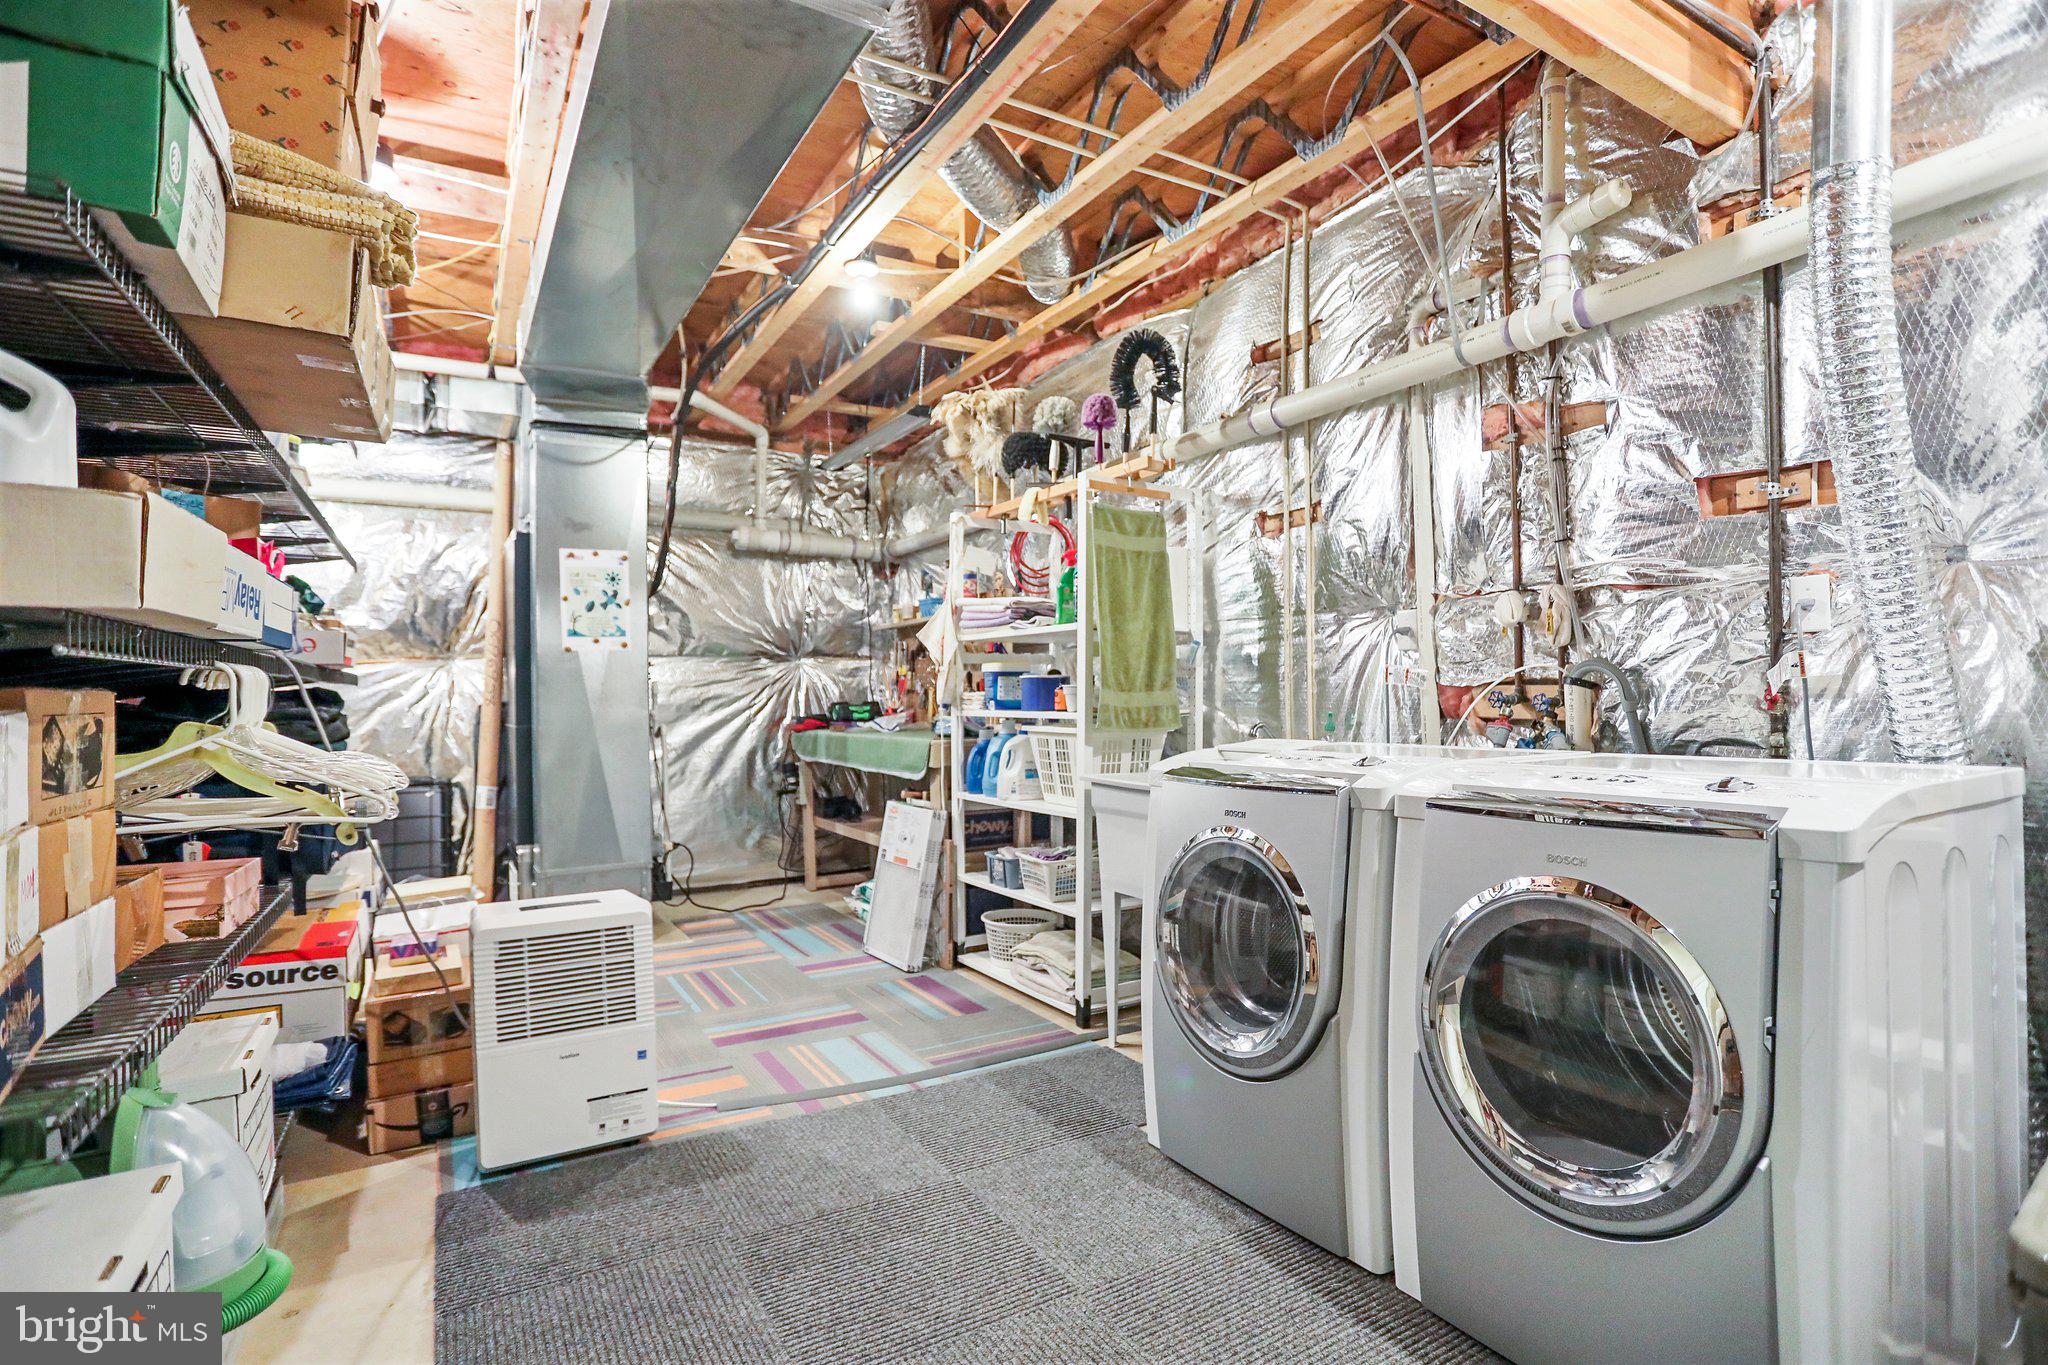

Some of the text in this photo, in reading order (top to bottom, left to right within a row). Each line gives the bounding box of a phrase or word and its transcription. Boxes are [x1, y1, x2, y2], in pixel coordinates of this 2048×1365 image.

[234, 574, 262, 620] Relay
[1224, 809, 1247, 819] BOSCH
[1546, 853, 1588, 867] BOSCH
[225, 964, 339, 989] source
